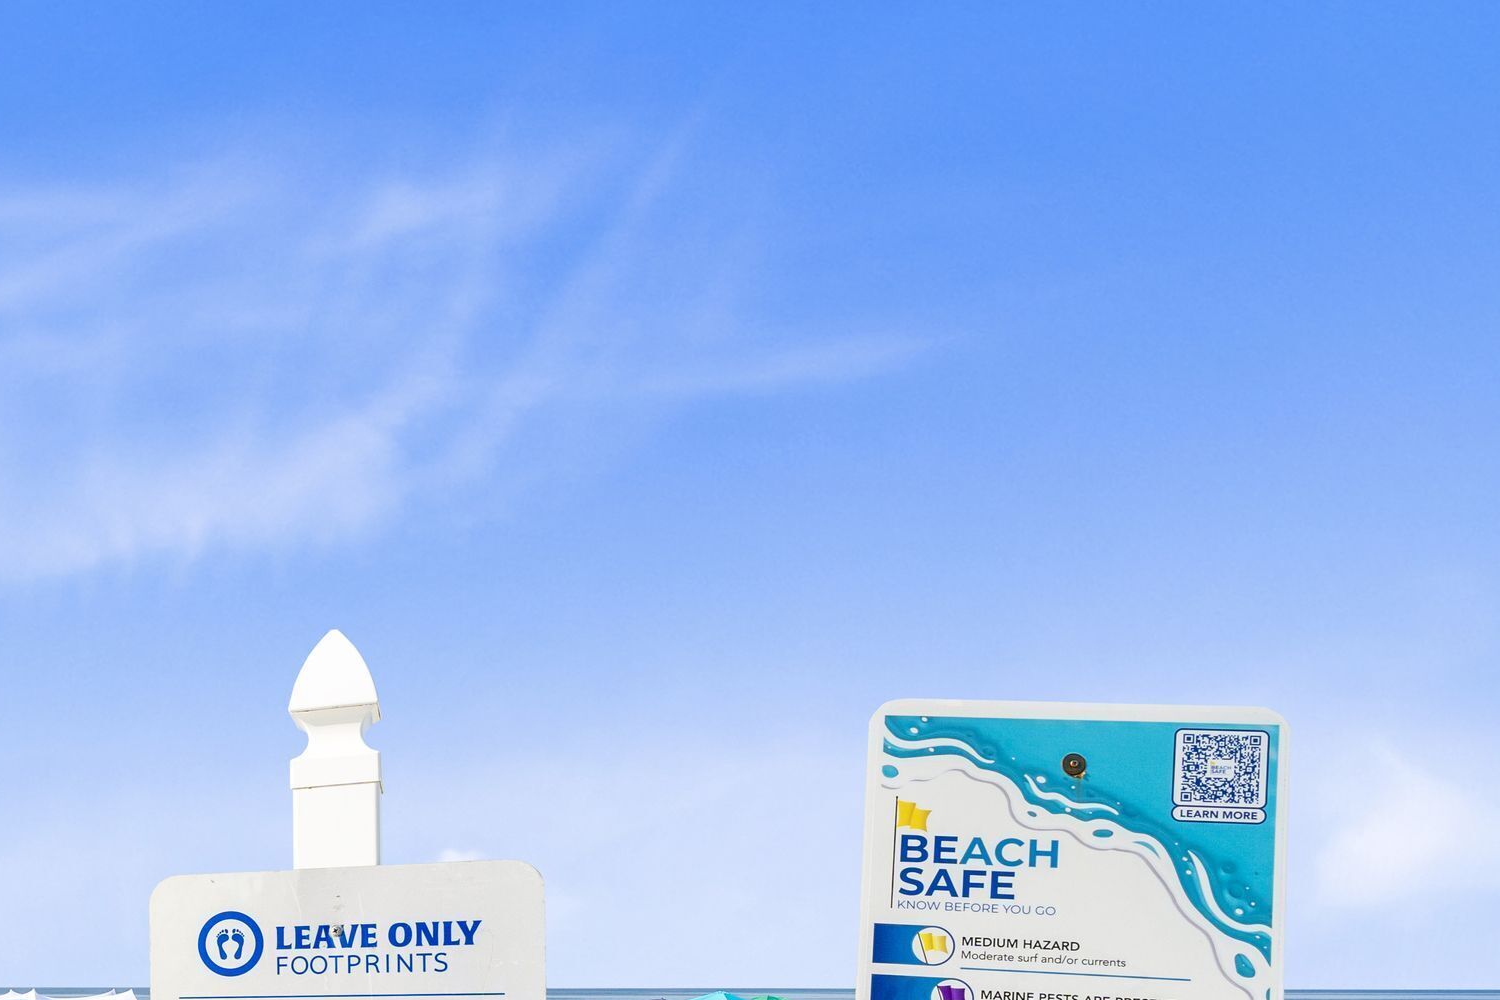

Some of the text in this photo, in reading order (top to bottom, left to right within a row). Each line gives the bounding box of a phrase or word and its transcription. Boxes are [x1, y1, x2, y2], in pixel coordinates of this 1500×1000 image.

[1179, 809, 1257, 821] LEARN MORE
[899, 834, 1059, 868] BEACH
[897, 866, 1016, 900] SAFE
[897, 899, 1056, 916] KNOW BEFORE YOU GO
[275, 919, 482, 950] LEAVE ONLY
[961, 936, 1080, 951] MEDIUM HAZARD
[276, 952, 448, 975] FOOTPRINTS
[960, 950, 1127, 968] Moderate surf and/or currents
